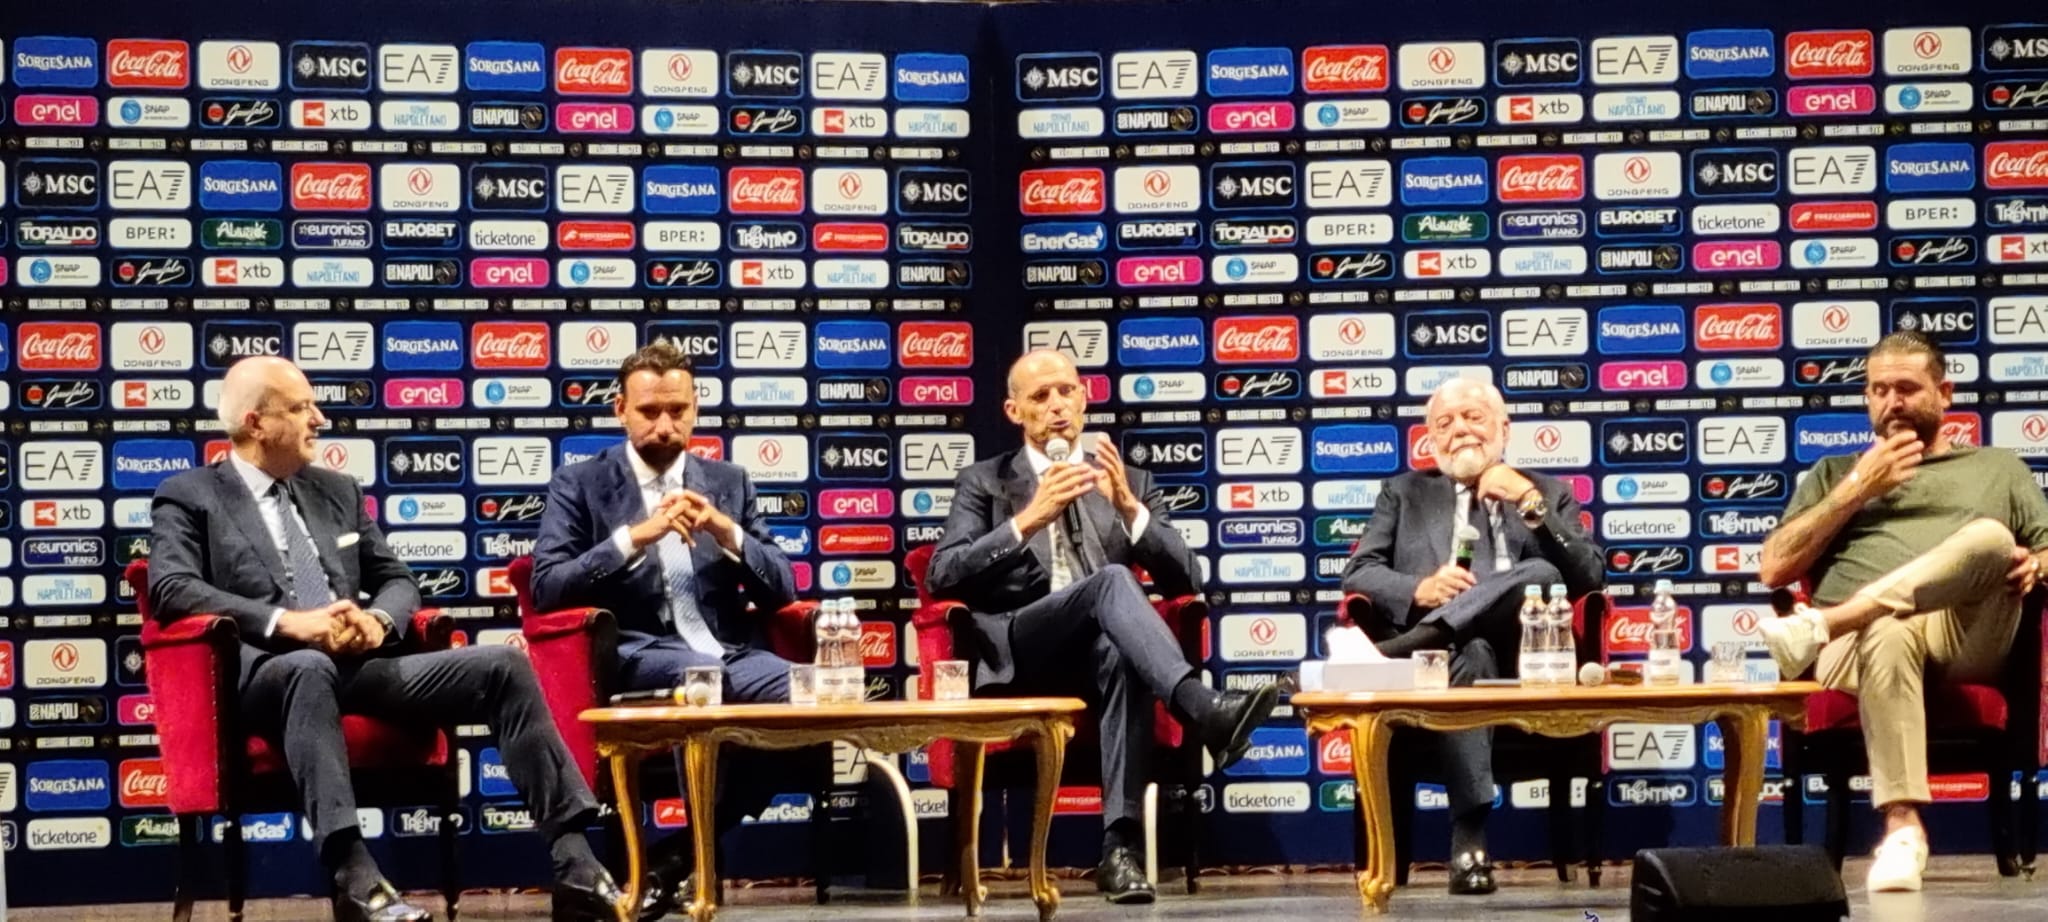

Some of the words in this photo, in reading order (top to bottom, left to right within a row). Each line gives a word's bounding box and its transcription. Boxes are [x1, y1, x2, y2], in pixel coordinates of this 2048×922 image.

[318, 57, 367, 77] MSC
[384, 54, 453, 83] EA7
[1525, 53, 1578, 74] MSC
[1597, 44, 1673, 75] EA7
[1897, 64, 1960, 72] DONGFENG
[753, 66, 799, 84] MSC
[816, 62, 881, 90] EA7
[1046, 68, 1098, 87] MSC
[1117, 59, 1192, 89] EA7
[1412, 78, 1473, 87] DONGFENG
[1539, 100, 1570, 114] xtb
[1705, 95, 1746, 112] NAPOLI
[1805, 90, 1857, 111] enel
[32, 101, 81, 121] enel
[331, 106, 359, 121] xtb
[483, 109, 519, 124] NAPOLI
[572, 109, 617, 128] enel
[1128, 111, 1168, 129] NAPOLI
[1226, 108, 1277, 128] enel
[849, 114, 875, 128] xtb
[1722, 163, 1775, 181] MSC
[1794, 154, 1870, 185] EA7
[46, 175, 95, 195] MSC
[113, 170, 185, 200] EA7
[497, 179, 545, 198] MSC
[561, 174, 630, 204] EA7
[1239, 176, 1292, 196] MSC
[1311, 168, 1385, 199] EA7
[1607, 188, 1669, 196] DONGFENG
[923, 184, 967, 202] MSC
[1128, 201, 1188, 209] DONGFENG
[1516, 213, 1578, 226] euronics
[1601, 210, 1677, 225] EUROBET
[1697, 213, 1766, 230] ticketone
[21, 225, 97, 241] TORALDO
[306, 224, 365, 237] euronics
[387, 223, 456, 238] EUROBET
[475, 230, 536, 246] ticketone
[901, 231, 969, 246] TORALDO
[1121, 223, 1196, 238] EUROBET
[1215, 224, 1294, 241] TORALDO
[1024, 234, 1098, 250] EnerGas
[1446, 255, 1477, 269] xtb
[1612, 250, 1652, 267] NAPOLI
[1711, 246, 1763, 266] enel
[242, 262, 271, 278] xtb
[397, 264, 433, 281] NAPOLI
[486, 263, 533, 282] enel
[767, 264, 794, 280] xtb
[910, 266, 944, 282] NAPOLI
[1037, 265, 1077, 282] NAPOLI
[1134, 260, 1185, 281] enel
[1921, 312, 1974, 333] MSC
[1435, 325, 1487, 345] MSC
[1506, 317, 1581, 347] EA7
[1805, 337, 1868, 345] DONGFENG
[231, 337, 280, 355] MSC
[298, 331, 368, 361] EA7
[673, 337, 718, 355] MSC
[735, 331, 801, 360] EA7
[1322, 348, 1383, 357] DONGFENG
[1352, 375, 1383, 388] xtb
[1517, 370, 1558, 386] NAPOLI
[1617, 366, 1668, 386] enel
[152, 385, 181, 402] xtb
[401, 384, 448, 404] enel
[829, 384, 864, 399] NAPOLI
[914, 381, 958, 401] enel
[1631, 433, 1684, 452] MSC
[1703, 425, 1779, 455] EA7
[843, 448, 888, 467] MSC
[904, 442, 970, 471] EA7
[1151, 443, 1203, 463] MSC
[1221, 436, 1297, 465] EA7
[25, 450, 97, 480] EA7
[412, 453, 461, 472] MSC
[478, 446, 546, 475] EA7
[1517, 456, 1579, 465] DONGFENG
[834, 493, 879, 515] enel
[1260, 489, 1290, 503] xtb
[62, 508, 91, 521] xtb
[1236, 522, 1297, 534] euronics
[1608, 520, 1676, 535] ticketone
[38, 541, 98, 553] euronics
[41, 703, 78, 719] NAPOLI
[1612, 731, 1689, 760] EA7
[1230, 794, 1295, 807] ticketone
[32, 829, 97, 844] ticketone
